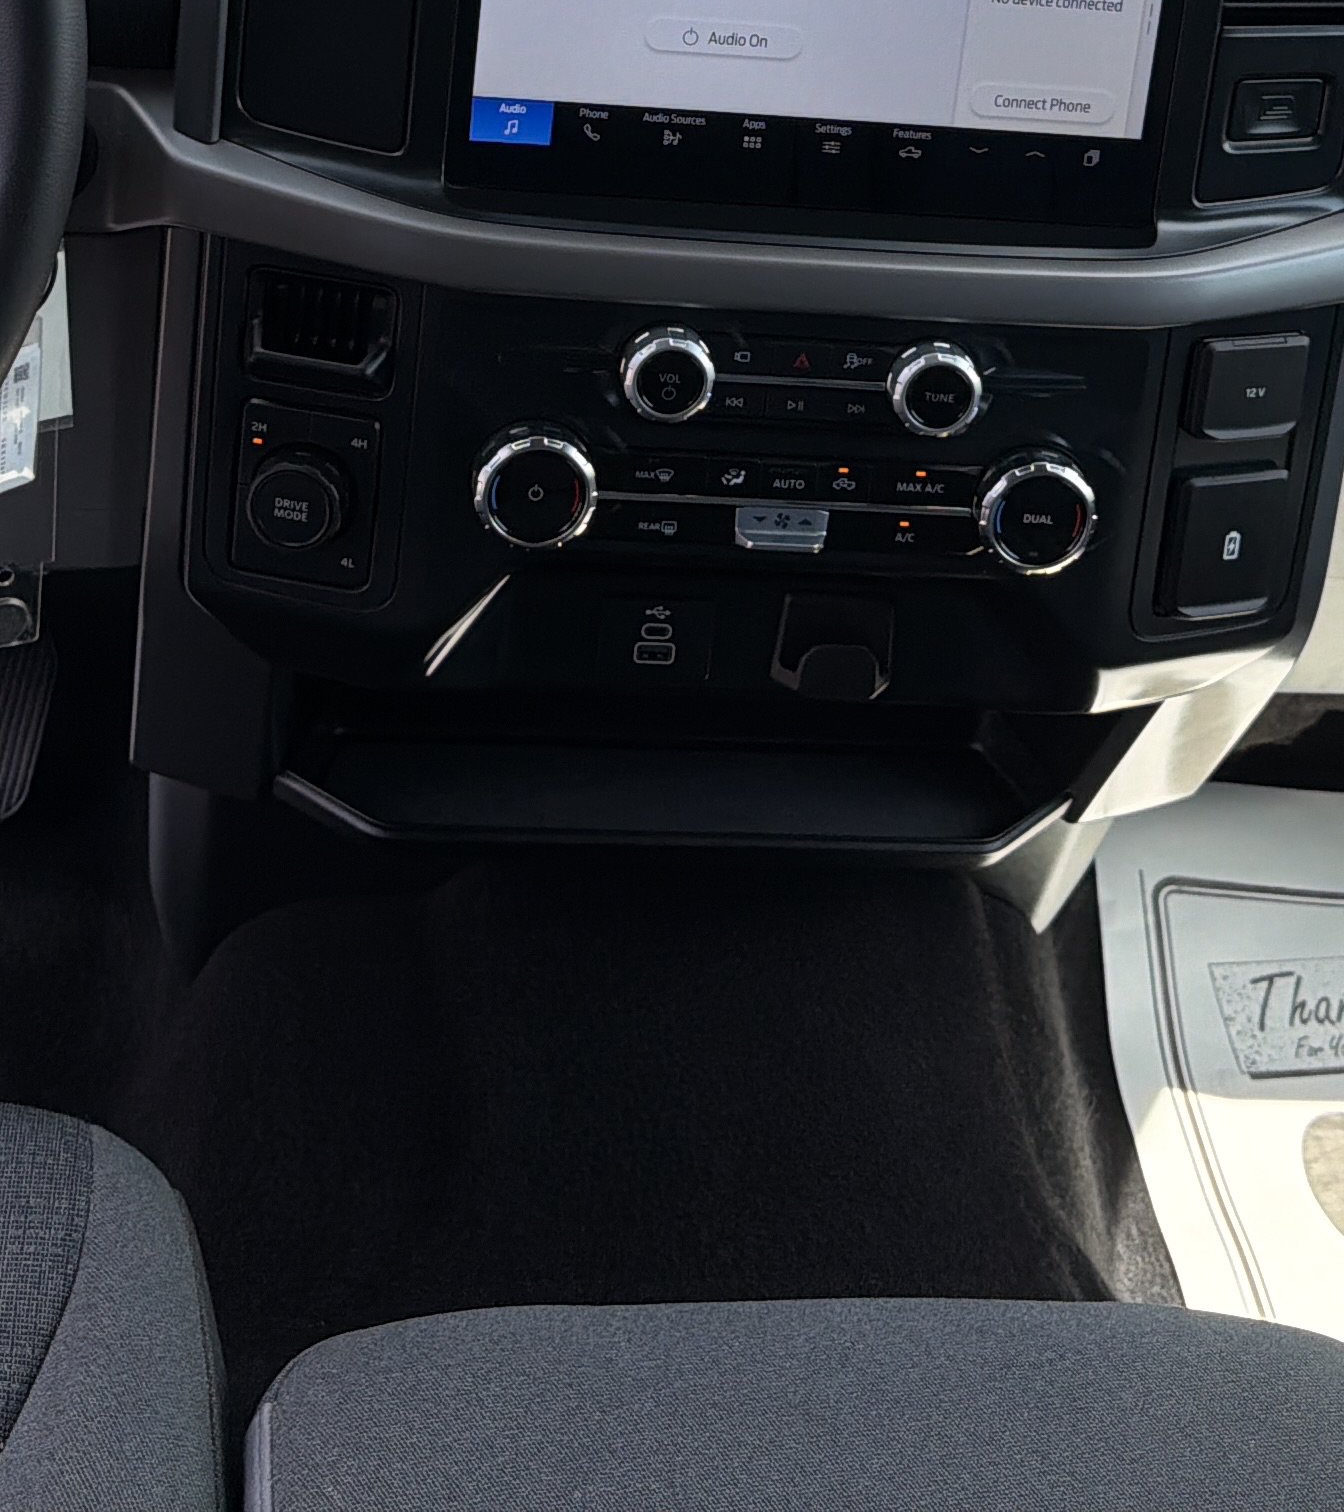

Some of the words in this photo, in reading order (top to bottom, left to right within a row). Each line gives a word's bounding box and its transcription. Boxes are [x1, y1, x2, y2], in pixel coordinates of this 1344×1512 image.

[708, 31, 747, 48] Audio
[750, 32, 769, 48] On
[499, 102, 527, 115] Audio
[993, 94, 1046, 113] Connect
[1047, 97, 1092, 115] Phone
[579, 108, 609, 121] Phone
[642, 110, 669, 124] Audio
[670, 113, 707, 126] Sources
[743, 118, 766, 132] Apps
[814, 122, 853, 137] Settings
[892, 127, 933, 141] Features
[659, 373, 681, 384] VOL
[924, 392, 955, 404] TUNE
[251, 421, 267, 432] 2H
[351, 437, 368, 450] 4H
[635, 470, 655, 480] MAX
[773, 478, 805, 490] AUTO
[896, 482, 922, 494] MAX
[924, 483, 945, 494] A/C
[274, 497, 309, 512] DRIVE
[273, 508, 308, 522] MODE
[1023, 513, 1054, 526] DUAL
[638, 521, 661, 531] REAR
[895, 532, 915, 543] A/C
[340, 557, 355, 569] 4L
[1294, 1035, 1321, 1058] For
